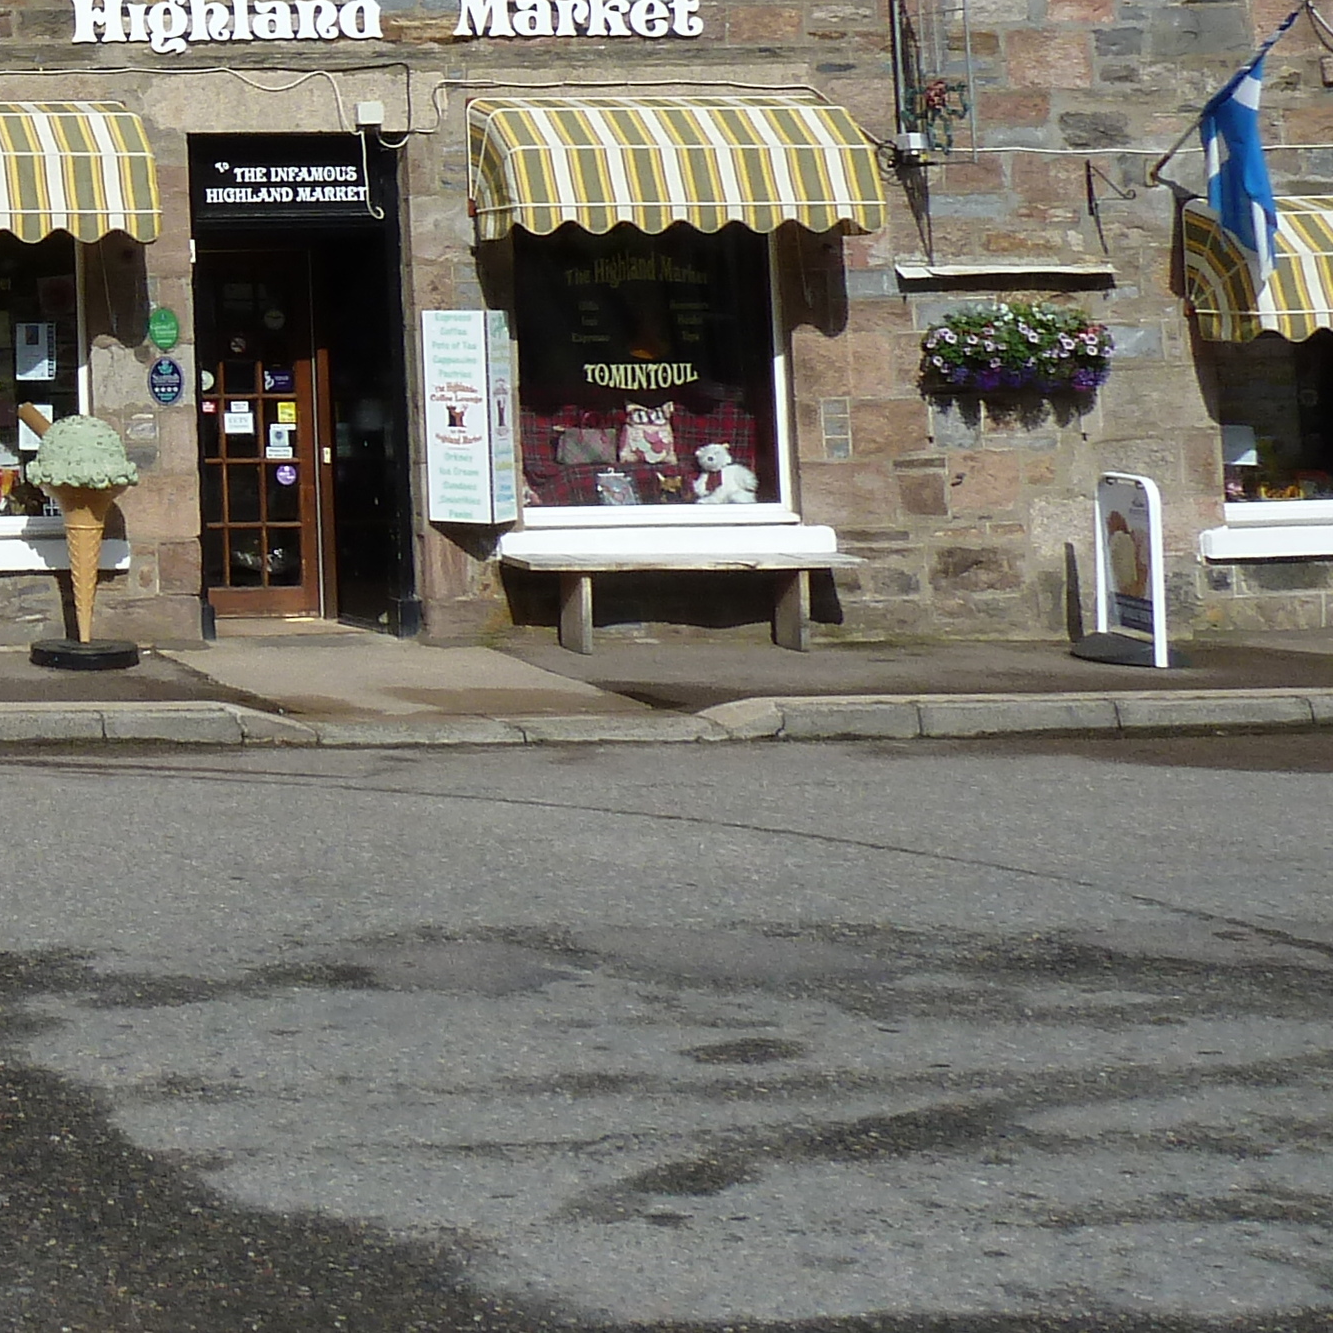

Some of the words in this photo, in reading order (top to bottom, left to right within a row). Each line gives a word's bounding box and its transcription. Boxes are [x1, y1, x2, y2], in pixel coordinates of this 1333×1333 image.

[233, 167, 268, 183] THE
[270, 166, 358, 182] INFAMOUS
[205, 187, 293, 204] HIGHLAND
[296, 186, 367, 202] MARKET
[583, 363, 700, 391] TOMINTOUL
